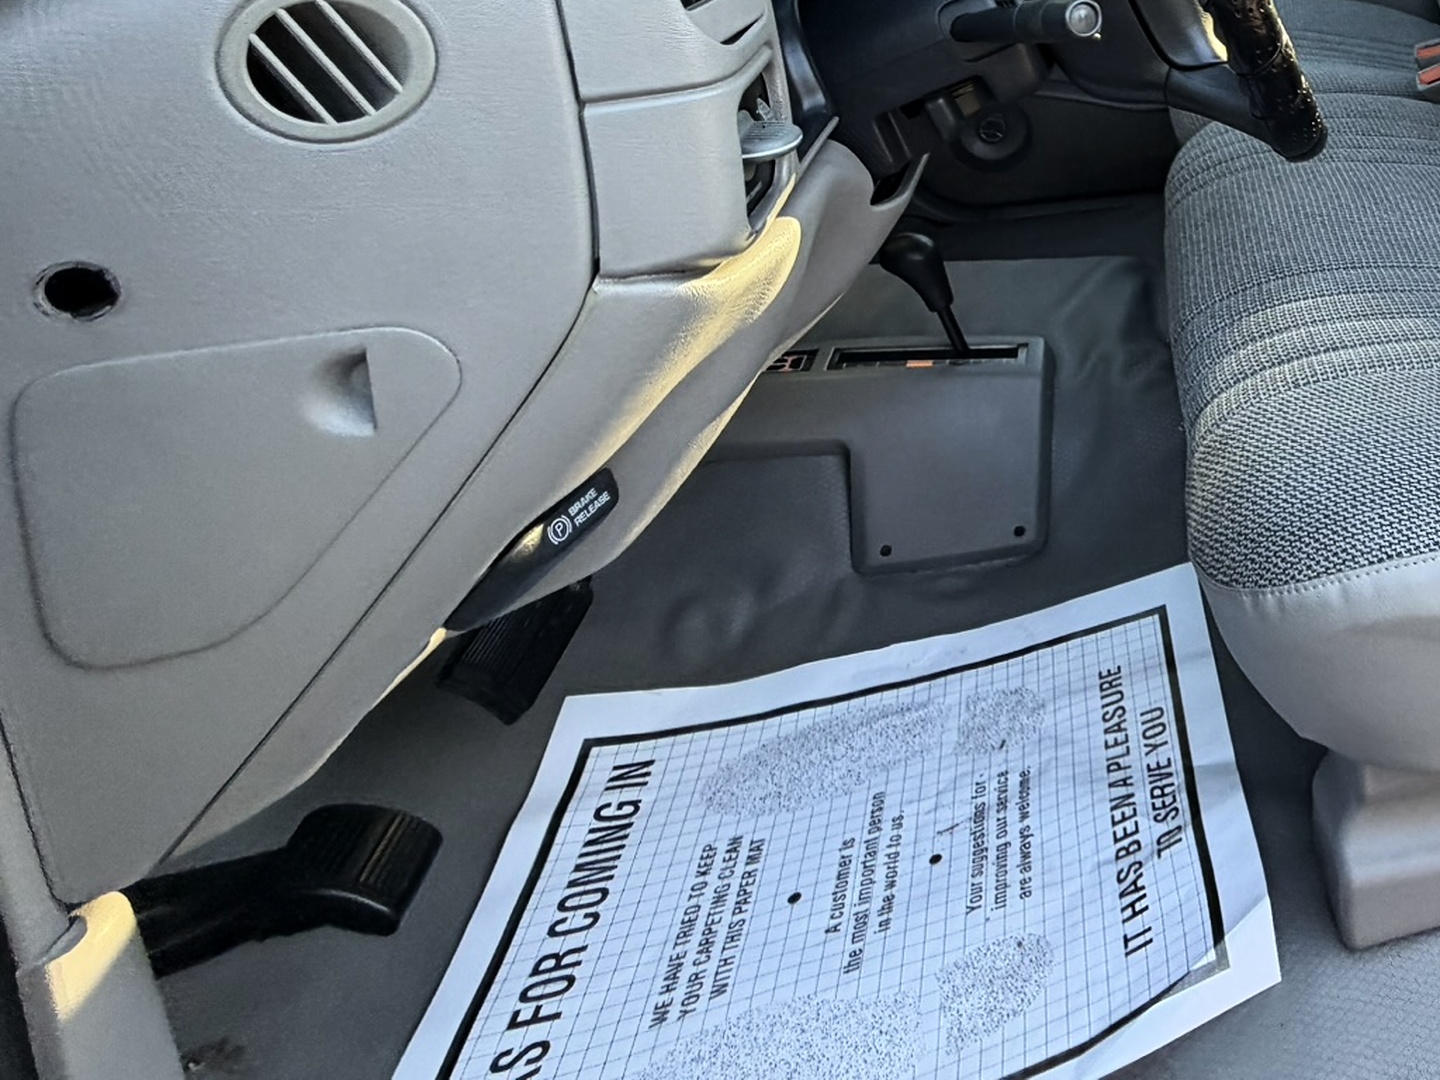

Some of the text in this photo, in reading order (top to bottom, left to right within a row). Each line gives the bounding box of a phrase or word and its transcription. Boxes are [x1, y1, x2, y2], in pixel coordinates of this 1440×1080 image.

[568, 487, 598, 517] BRAKE
[573, 491, 611, 527] RELEASE
[1099, 665, 1153, 958] IT HAS BEEN A PLEASURE
[1140, 706, 1183, 859] TO SERVE YOU
[825, 837, 855, 934] A customer is
[843, 790, 886, 975] the most important person
[883, 852, 900, 892] world
[886, 834, 902, 850] to
[966, 781, 988, 915] Your suggestions for
[991, 771, 1011, 911] improving our service
[1016, 824, 1034, 875] always
[1019, 876, 1032, 900] are
[489, 759, 656, 1080] S FOR COMING IN
[648, 843, 718, 1029] WE HAVE TRIED TO KEEP
[678, 835, 744, 1021] YOUR CARPETING CLEAN
[709, 837, 766, 1001] WITH THIS PAPER MAT
[873, 919, 892, 934] in
[877, 894, 895, 918] the
